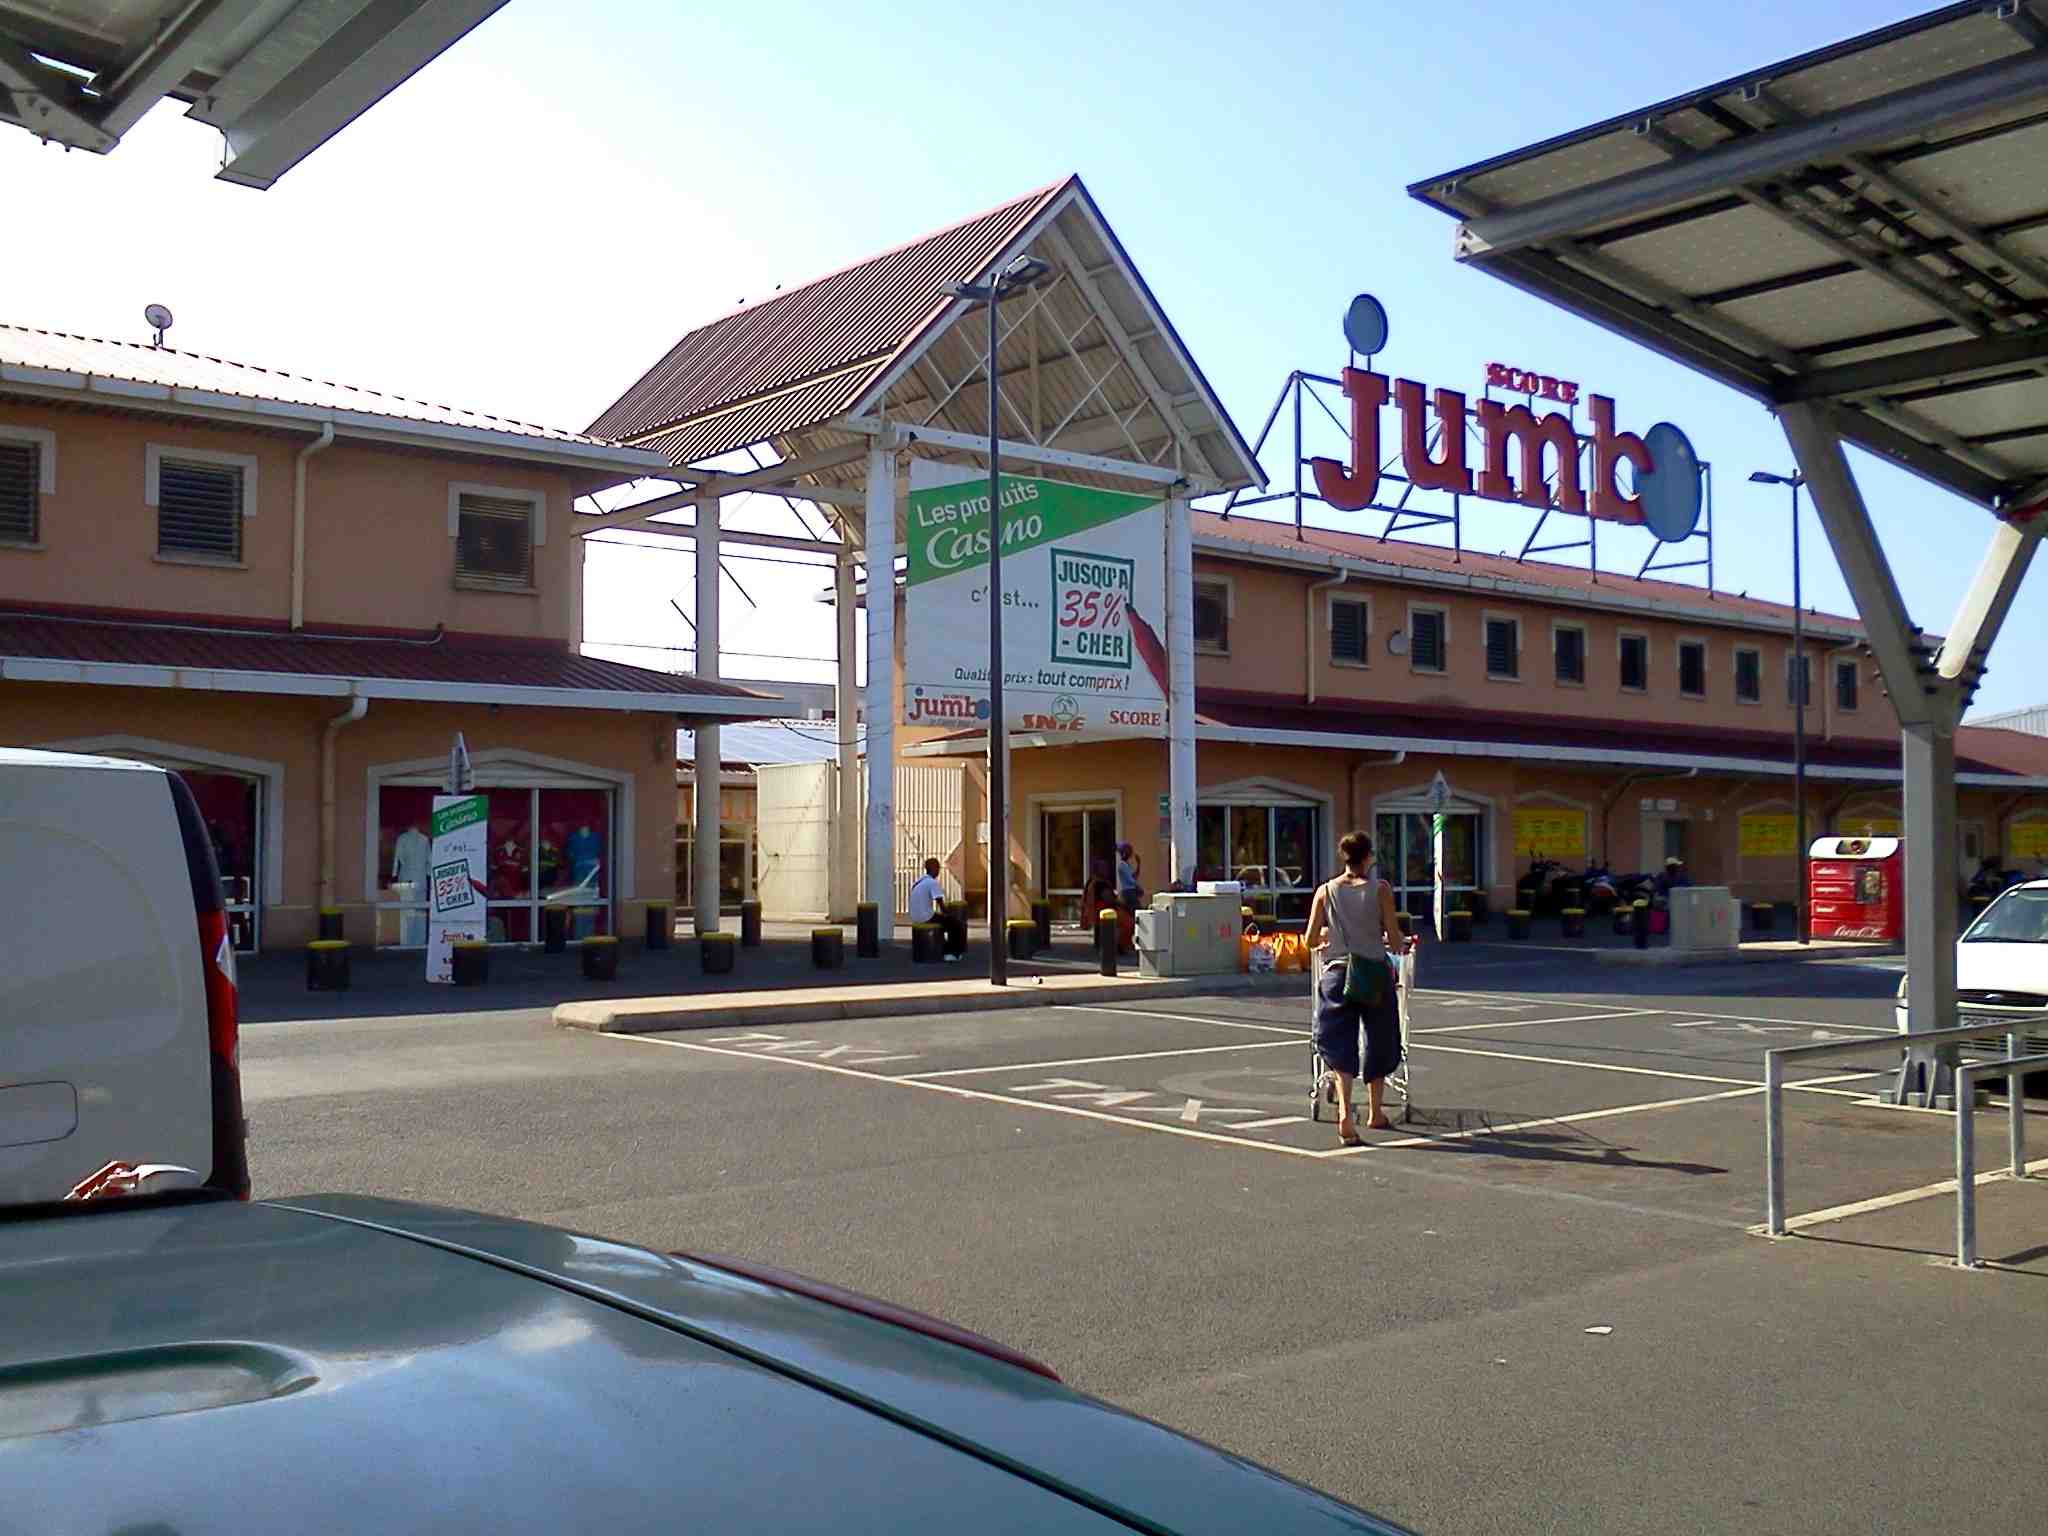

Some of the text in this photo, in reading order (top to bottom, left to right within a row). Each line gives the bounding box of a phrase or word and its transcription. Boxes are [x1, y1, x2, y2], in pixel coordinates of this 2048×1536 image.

[1485, 362, 1579, 406] SCORE
[917, 482, 1039, 527] Les prouits
[926, 514, 1042, 569] Casno
[971, 585, 1039, 608] c'st...
[1059, 589, 1122, 630] 35%
[1076, 631, 1124, 657] CHER
[1037, 669, 1067, 687] tout
[1109, 710, 1161, 727] SCORE
